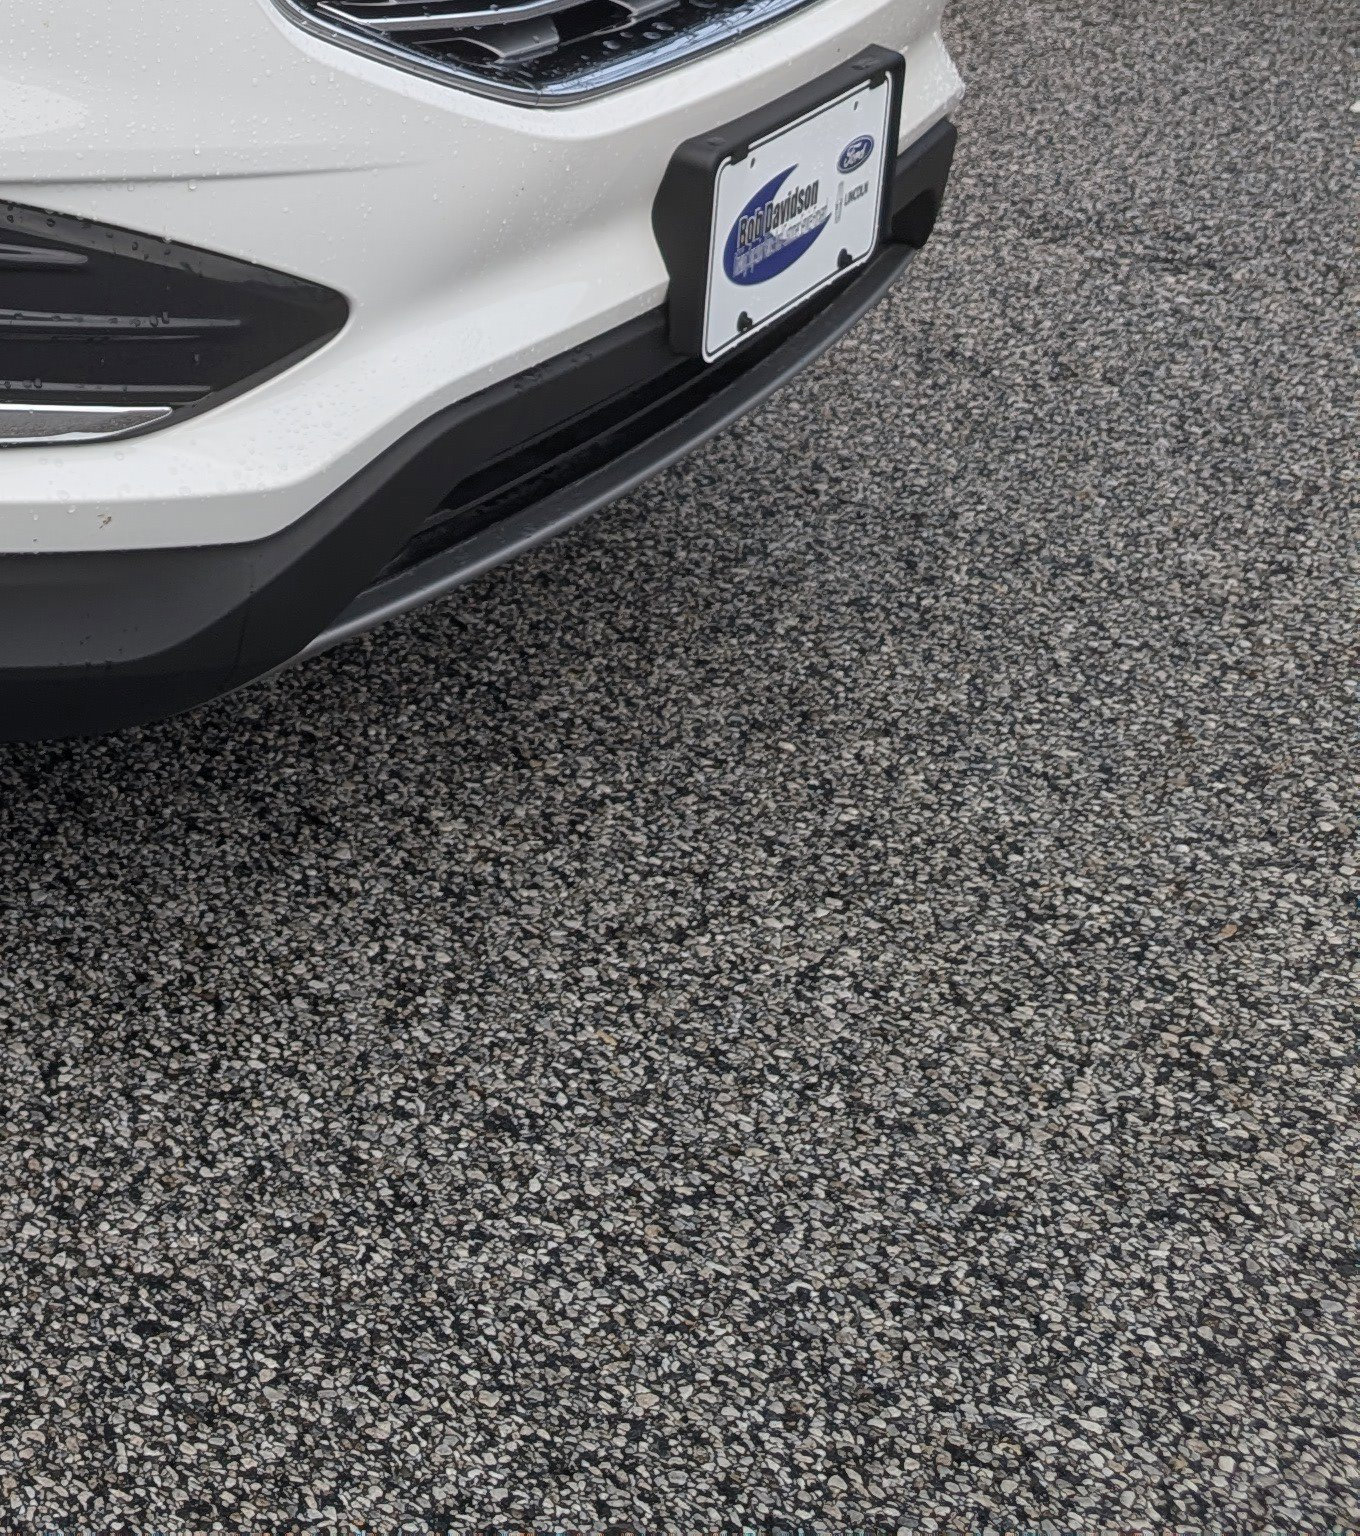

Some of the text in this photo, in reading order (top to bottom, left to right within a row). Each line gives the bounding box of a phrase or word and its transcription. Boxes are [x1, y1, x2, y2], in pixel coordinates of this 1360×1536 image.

[843, 142, 868, 168] Ford
[739, 211, 764, 246] Bob
[765, 179, 819, 234] Davidson
